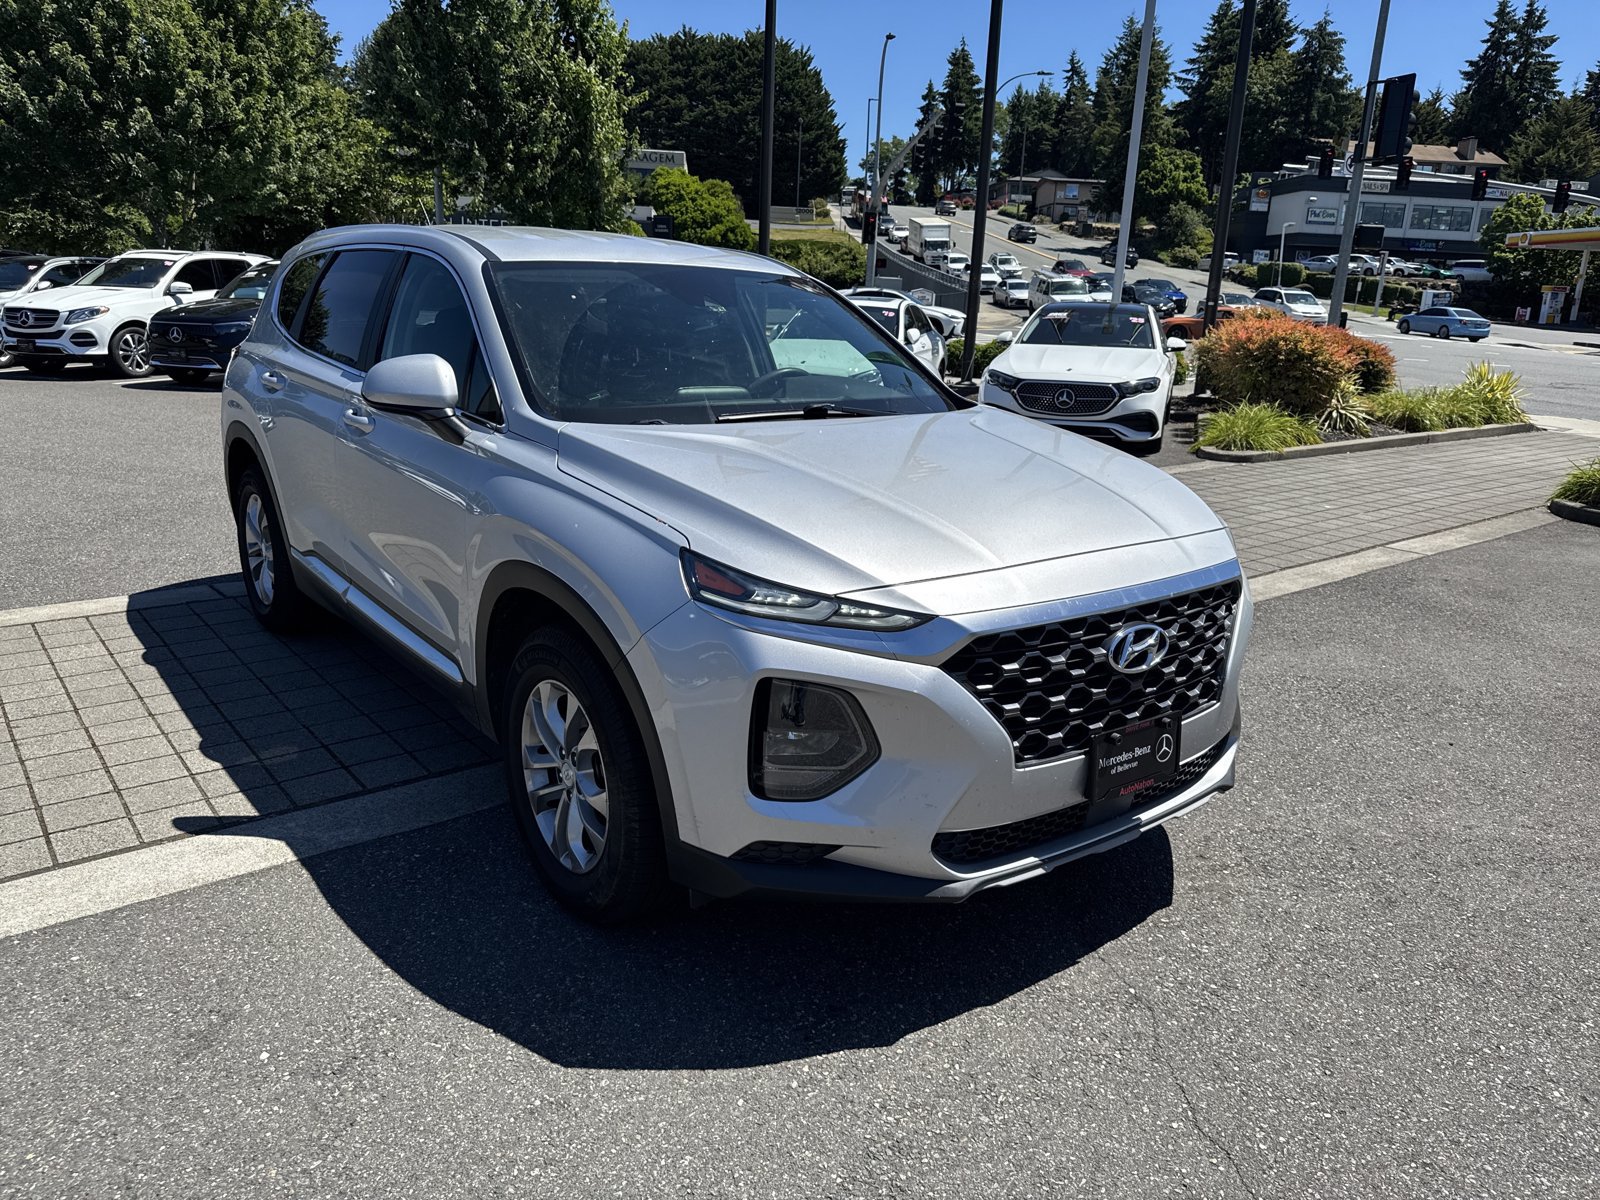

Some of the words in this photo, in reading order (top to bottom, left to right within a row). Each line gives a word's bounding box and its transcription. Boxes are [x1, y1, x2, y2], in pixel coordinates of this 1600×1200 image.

[1098, 745, 1151, 769] Mercedes-Benz
[1110, 766, 1116, 774] of
[1117, 761, 1138, 772] Bellevue
[1119, 779, 1154, 796] AutoNation
